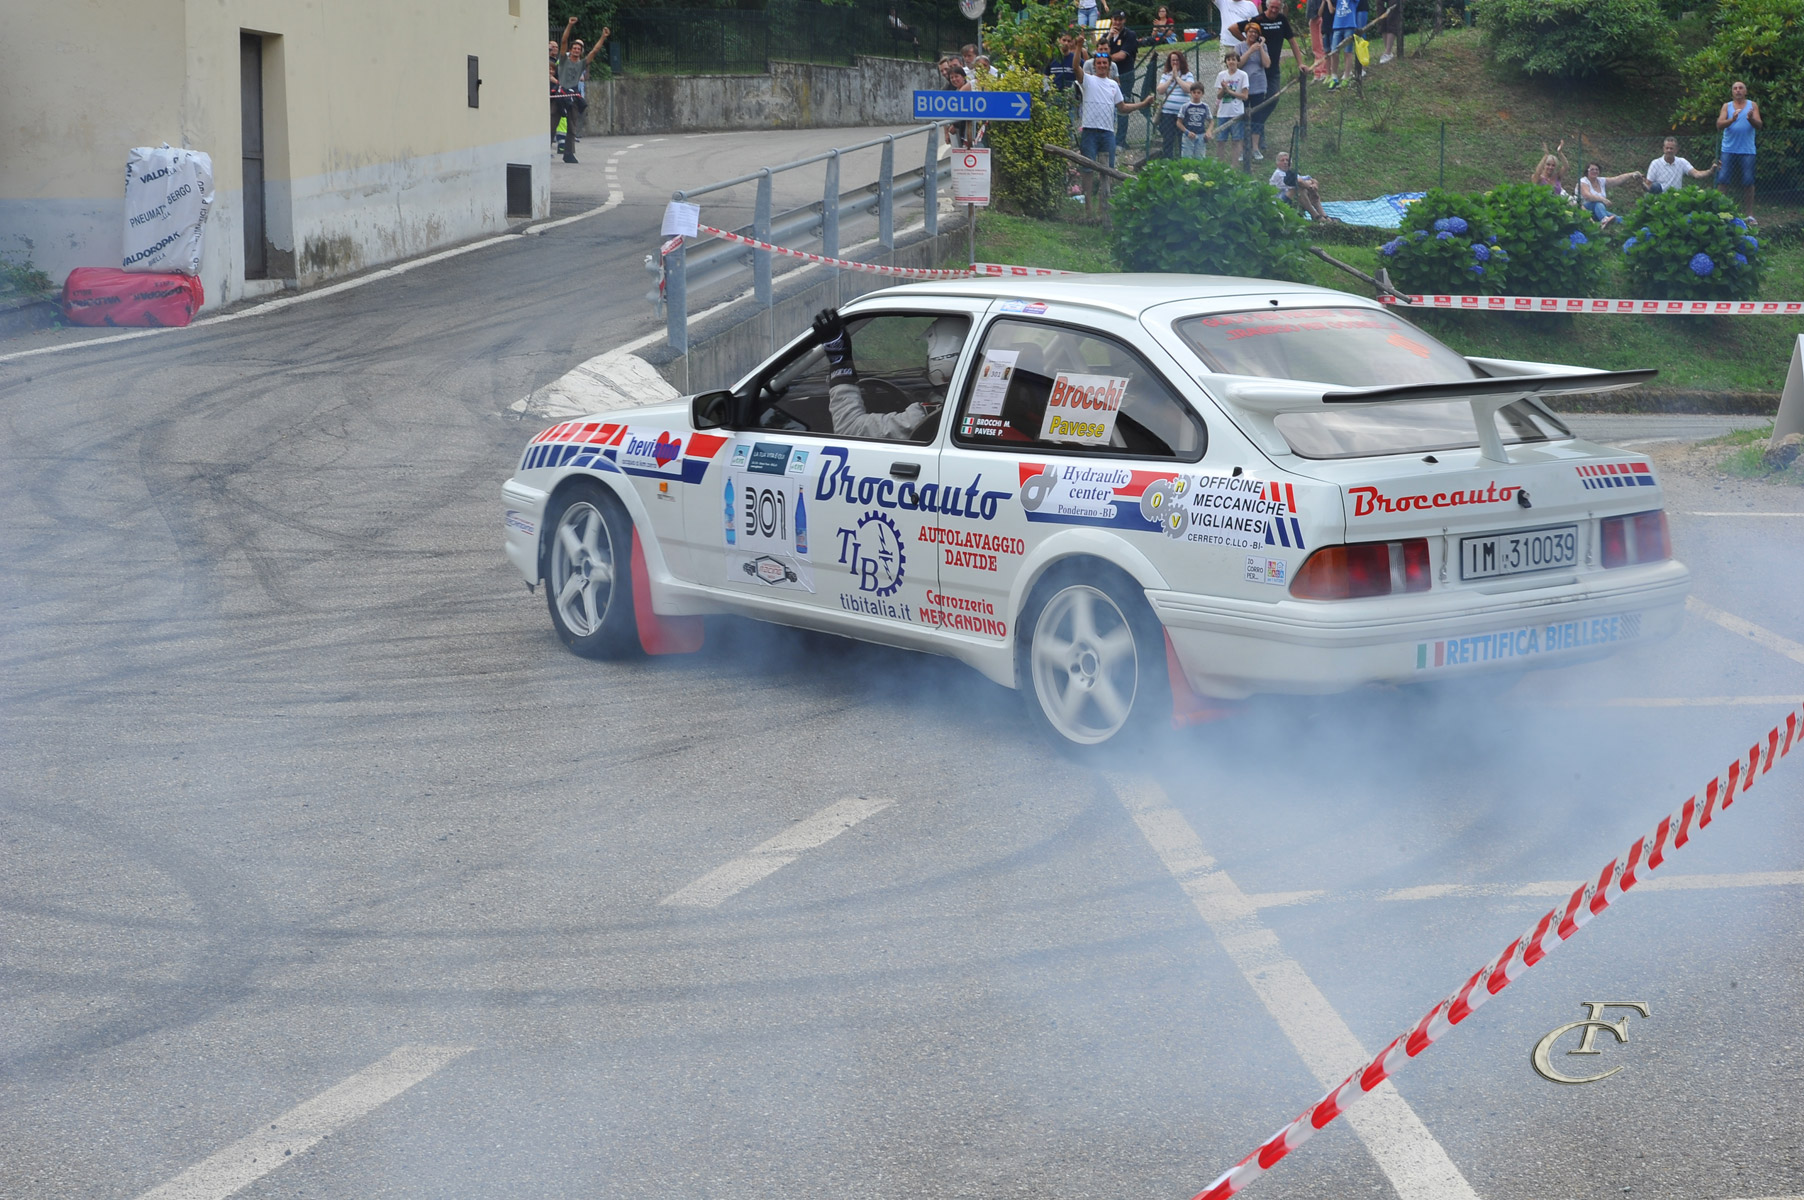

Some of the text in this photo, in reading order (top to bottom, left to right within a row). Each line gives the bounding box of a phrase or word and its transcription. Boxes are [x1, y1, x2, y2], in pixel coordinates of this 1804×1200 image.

[917, 96, 987, 112] BIOGLIO
[1050, 375, 1126, 412] Brocchi
[974, 427, 997, 436] PAVESE
[976, 418, 1011, 428] BROCCHI M.
[1049, 416, 1105, 438] Pavese
[815, 446, 1012, 521] Broccauto
[1062, 465, 1130, 486] Hydraulic
[1199, 475, 1263, 495] OFFICINE
[1069, 487, 1112, 502] center
[1193, 494, 1286, 517] MECCANICHE
[1348, 480, 1522, 517] Broccauto
[746, 486, 787, 541] 301
[1057, 504, 1097, 517] Ponderano
[1190, 512, 1267, 535] VIGLIANESI
[918, 526, 1025, 556] AUTOLAVAGGIO
[1187, 532, 1224, 545] CERRETO
[1225, 536, 1249, 549] C.LLO
[1510, 533, 1575, 568] 310039
[945, 549, 998, 572] DAVIDE
[840, 593, 911, 621] tibitalia.it
[926, 589, 994, 616] Carrozzeria
[919, 607, 1008, 638] MERCANDINO
[1446, 616, 1620, 666] RETTIFICA BIELLESE
